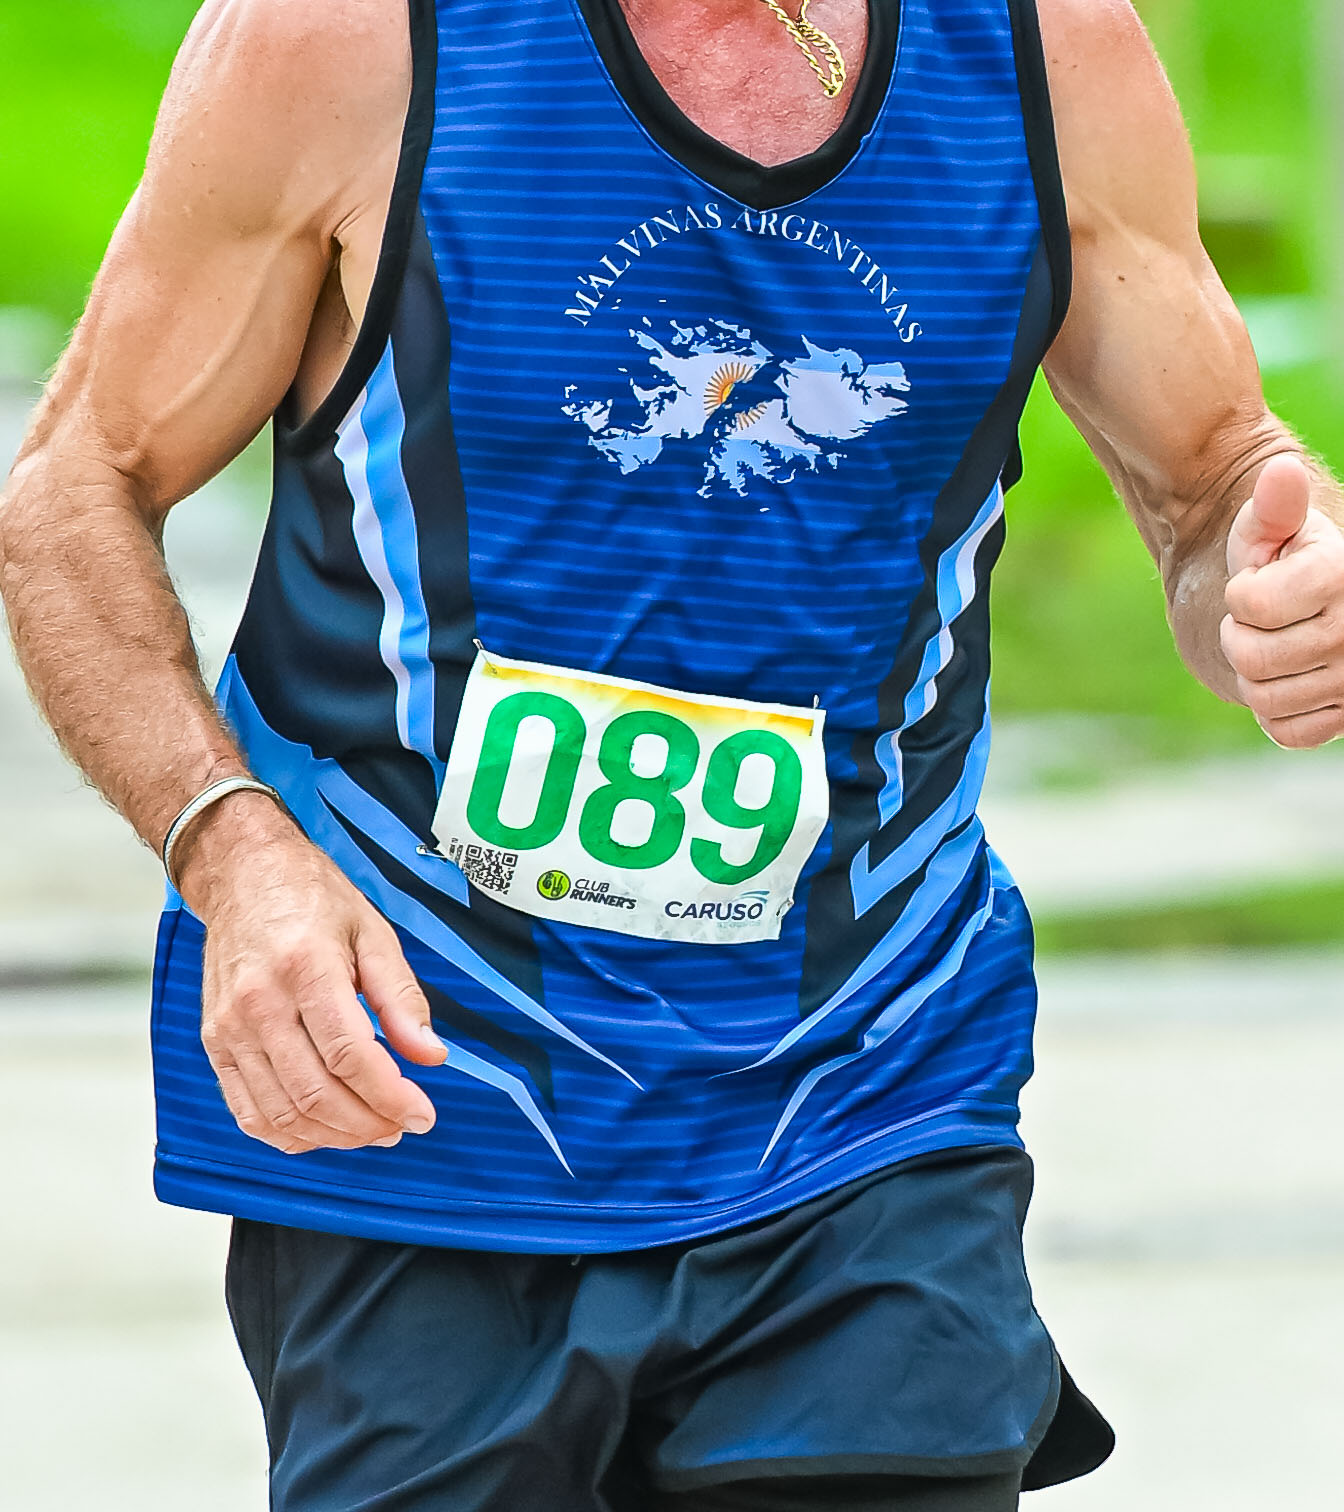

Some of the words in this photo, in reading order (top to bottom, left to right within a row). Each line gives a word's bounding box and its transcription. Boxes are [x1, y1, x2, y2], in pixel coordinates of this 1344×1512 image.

[564, 202, 723, 327] MALVINAS
[731, 211, 923, 343] ARGENTINAS
[466, 691, 803, 886] 089
[574, 878, 611, 893] CLUB
[665, 901, 763, 920] CARUSO
